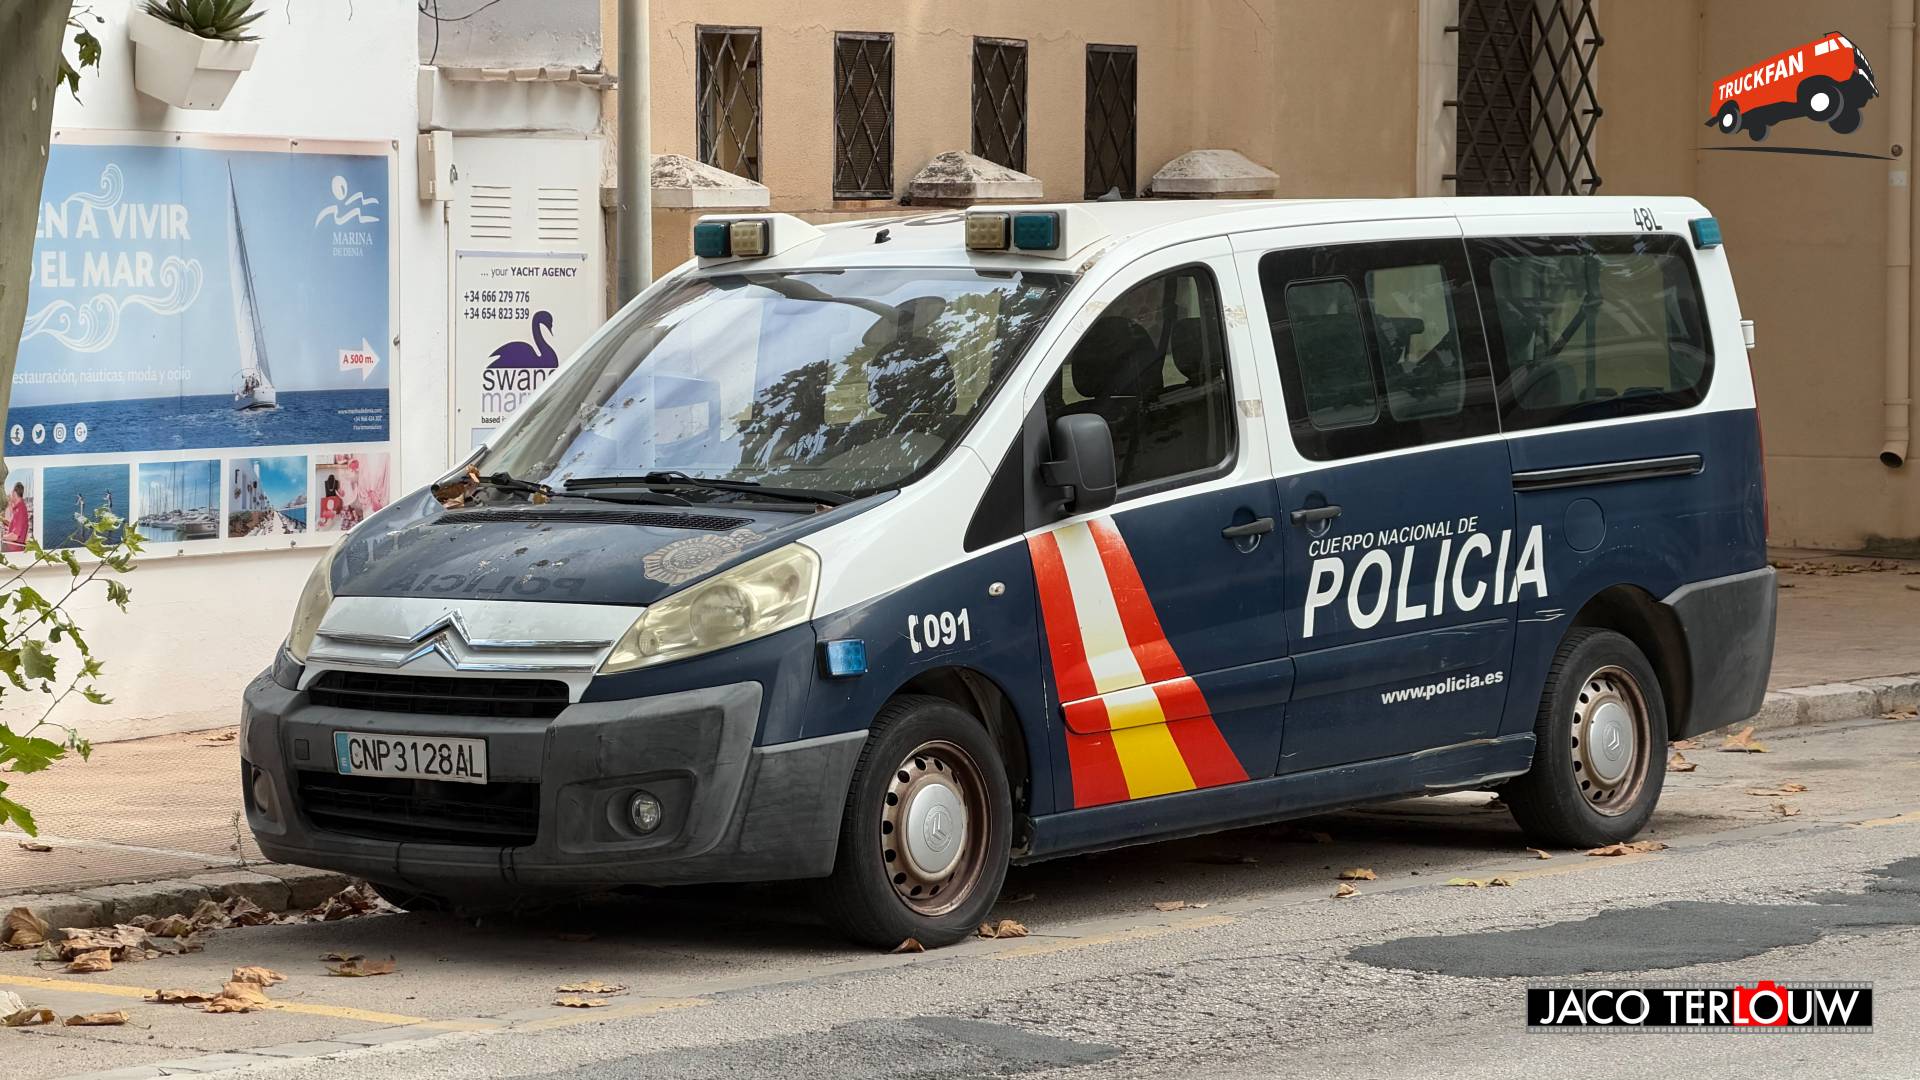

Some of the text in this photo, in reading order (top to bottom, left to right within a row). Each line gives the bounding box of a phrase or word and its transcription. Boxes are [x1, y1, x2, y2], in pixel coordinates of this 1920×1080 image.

[75, 202, 100, 239] A
[106, 203, 191, 240] VIVIR
[1633, 207, 1663, 232] 48L
[332, 231, 373, 245] MARINA
[333, 247, 342, 256] DE
[41, 250, 76, 288] EL
[82, 251, 155, 288] MAR
[491, 268, 508, 278] your
[511, 266, 540, 277] YACHT
[541, 267, 577, 277] AGENCY
[464, 290, 530, 303] +34 666 279 776
[464, 307, 530, 320] +34 654 823 539
[343, 354, 349, 364] A
[350, 354, 364, 364] 500
[127, 365, 157, 382] moda
[158, 370, 166, 385] y
[482, 368, 556, 391] swan
[481, 415, 500, 423] based
[1308, 515, 1479, 557] CUERPO NACIONAL DE
[1303, 524, 1548, 638] POLICIA
[923, 607, 971, 648] 091
[1381, 670, 1504, 705] www.policia.es
